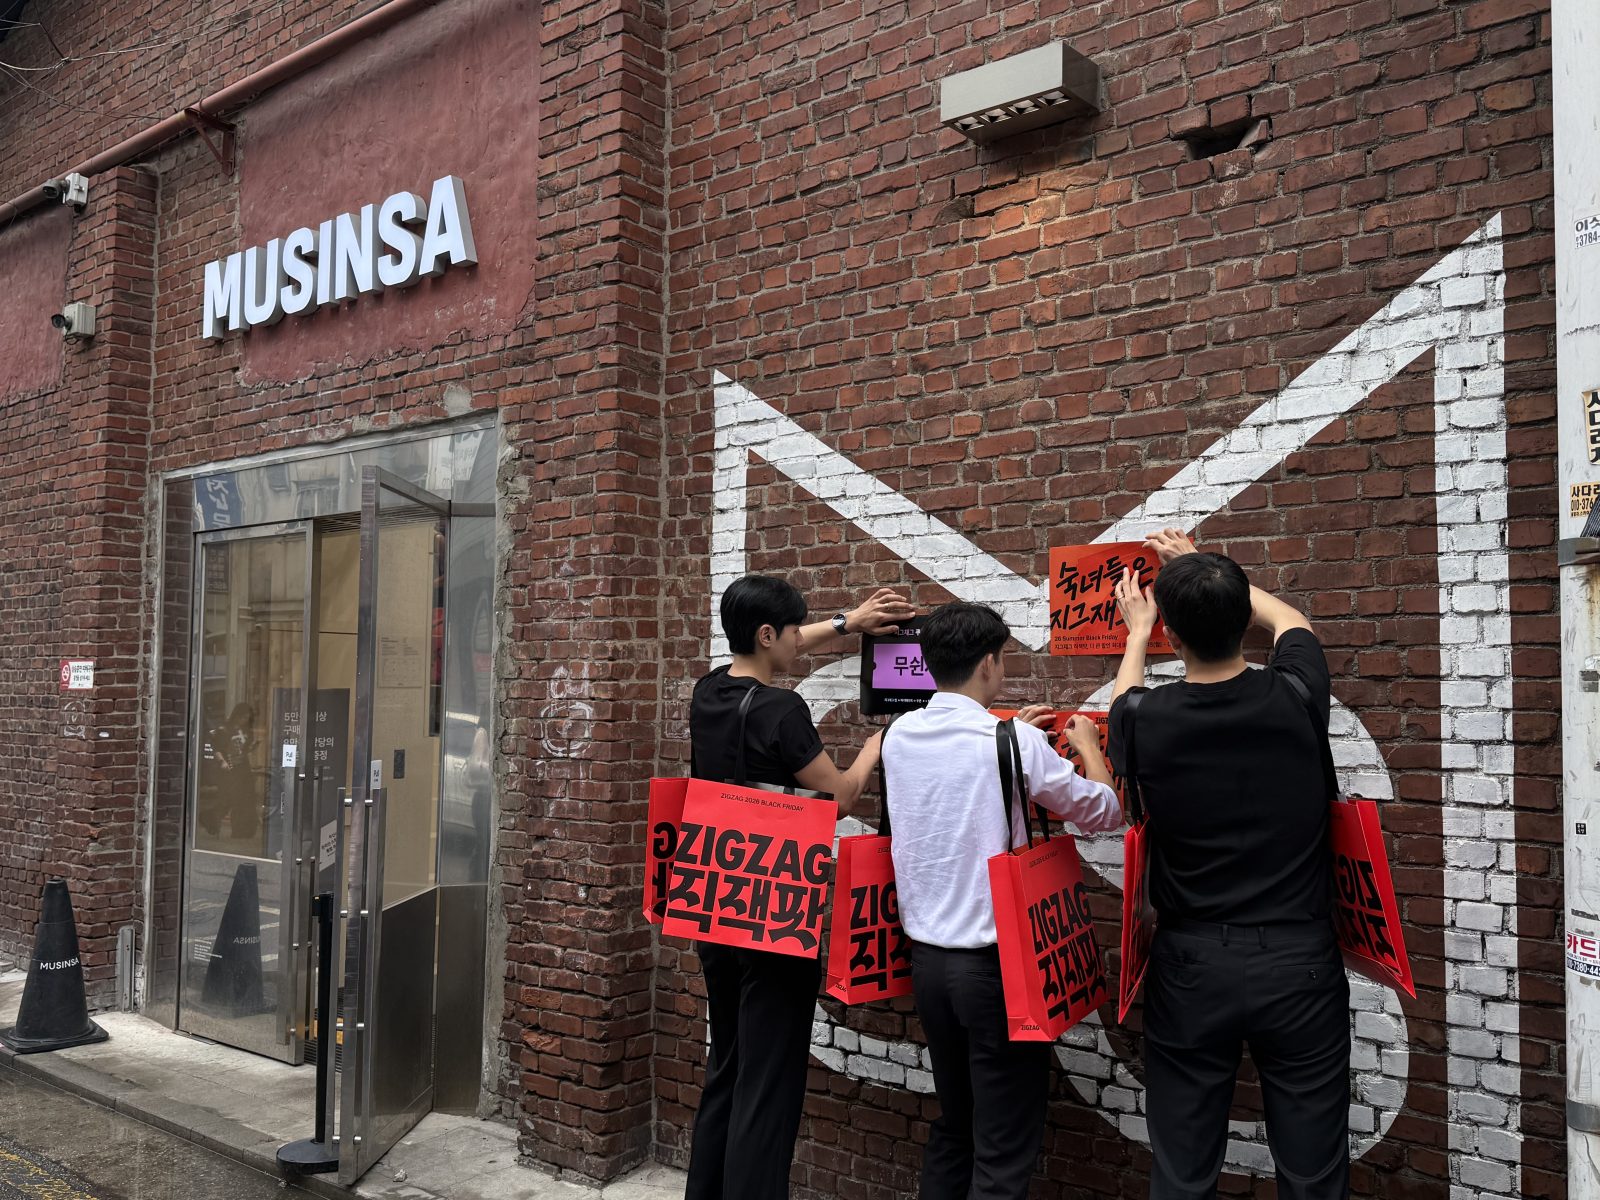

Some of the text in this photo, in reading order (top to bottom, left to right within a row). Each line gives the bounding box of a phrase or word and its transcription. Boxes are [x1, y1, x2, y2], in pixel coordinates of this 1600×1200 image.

[202, 174, 476, 341] MUSINSA
[1050, 598, 1125, 631] 지그재
[893, 656, 929, 677] 무쉰
[720, 792, 804, 812] ZIGZAG 2026 BLACK FRIDAY
[674, 821, 832, 885] ZIGZAG
[666, 865, 828, 952] 직잭팟
[1027, 881, 1093, 956] ZIGZAG
[1567, 933, 1600, 959] 카드
[39, 956, 80, 971] MUSINSA
[1020, 1023, 1041, 1031] ZIGZAG
